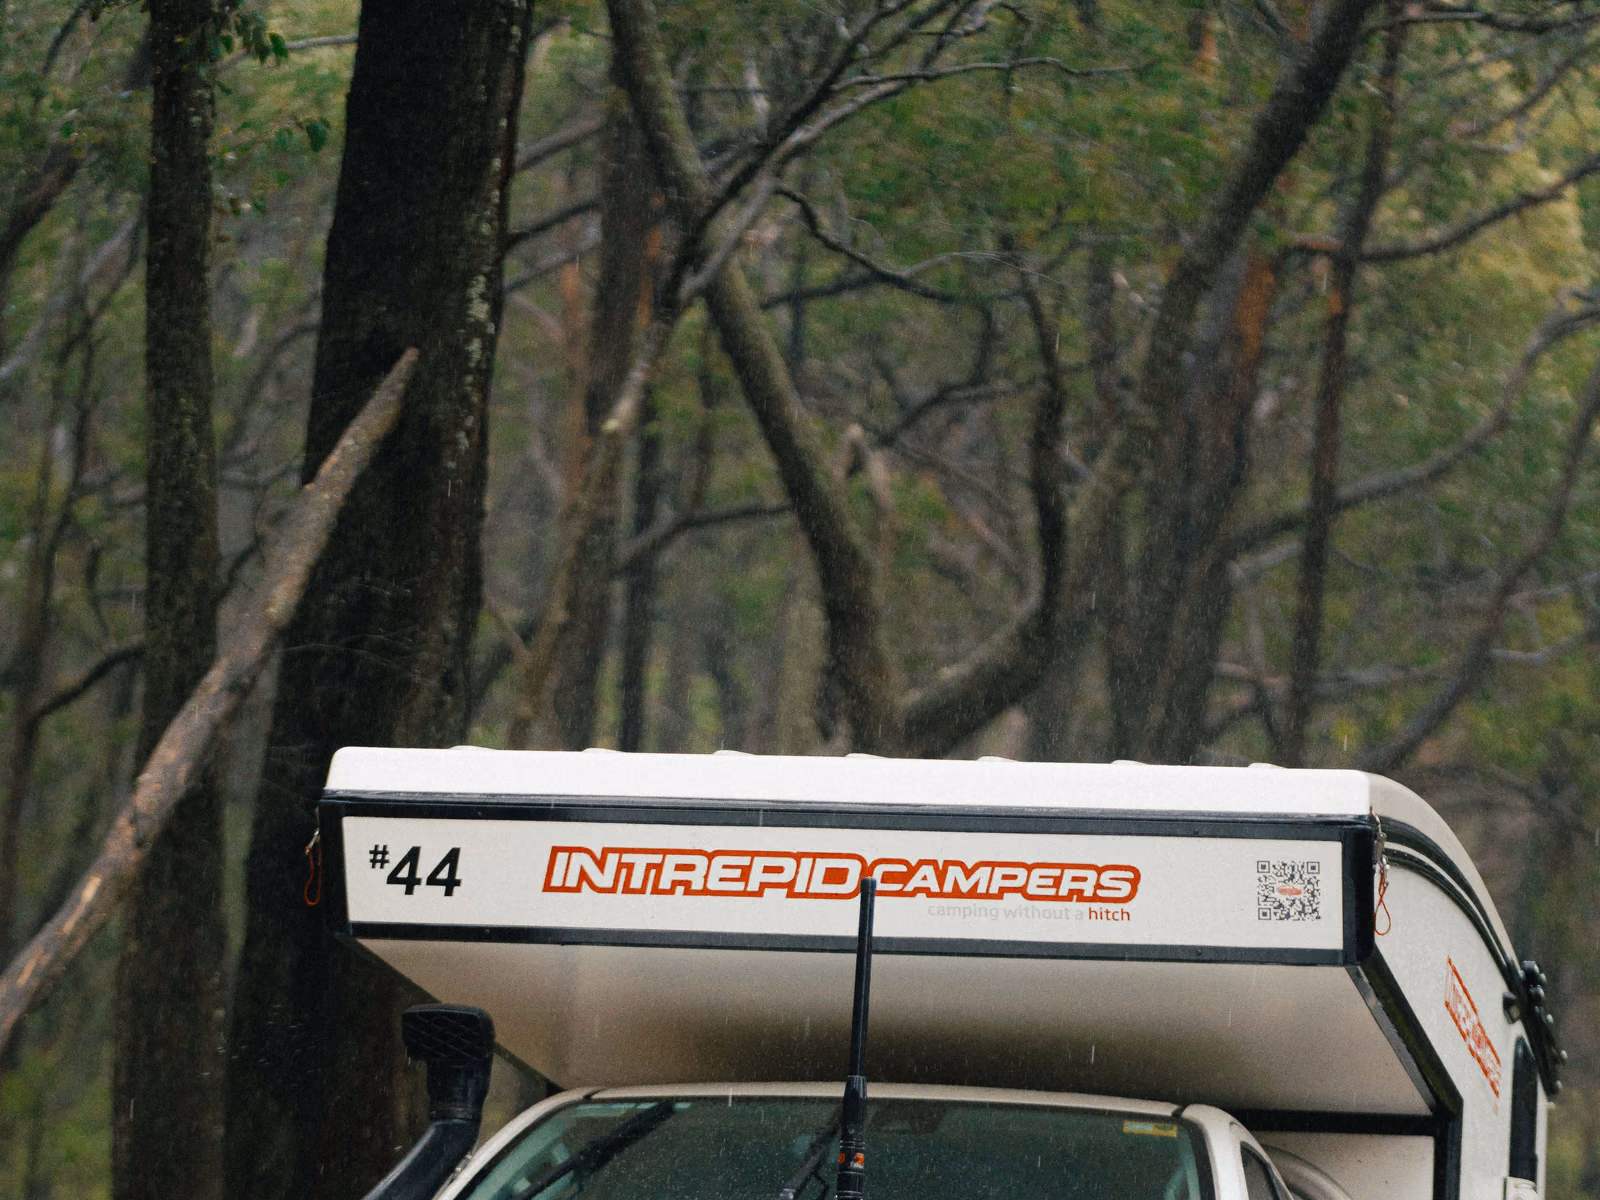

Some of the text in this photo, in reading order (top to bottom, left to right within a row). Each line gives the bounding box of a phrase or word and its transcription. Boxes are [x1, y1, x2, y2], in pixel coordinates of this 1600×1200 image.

[368, 843, 462, 897] #44
[543, 846, 1141, 903] INTREPID CAMPERS
[928, 902, 1131, 921] camping without a hitch
